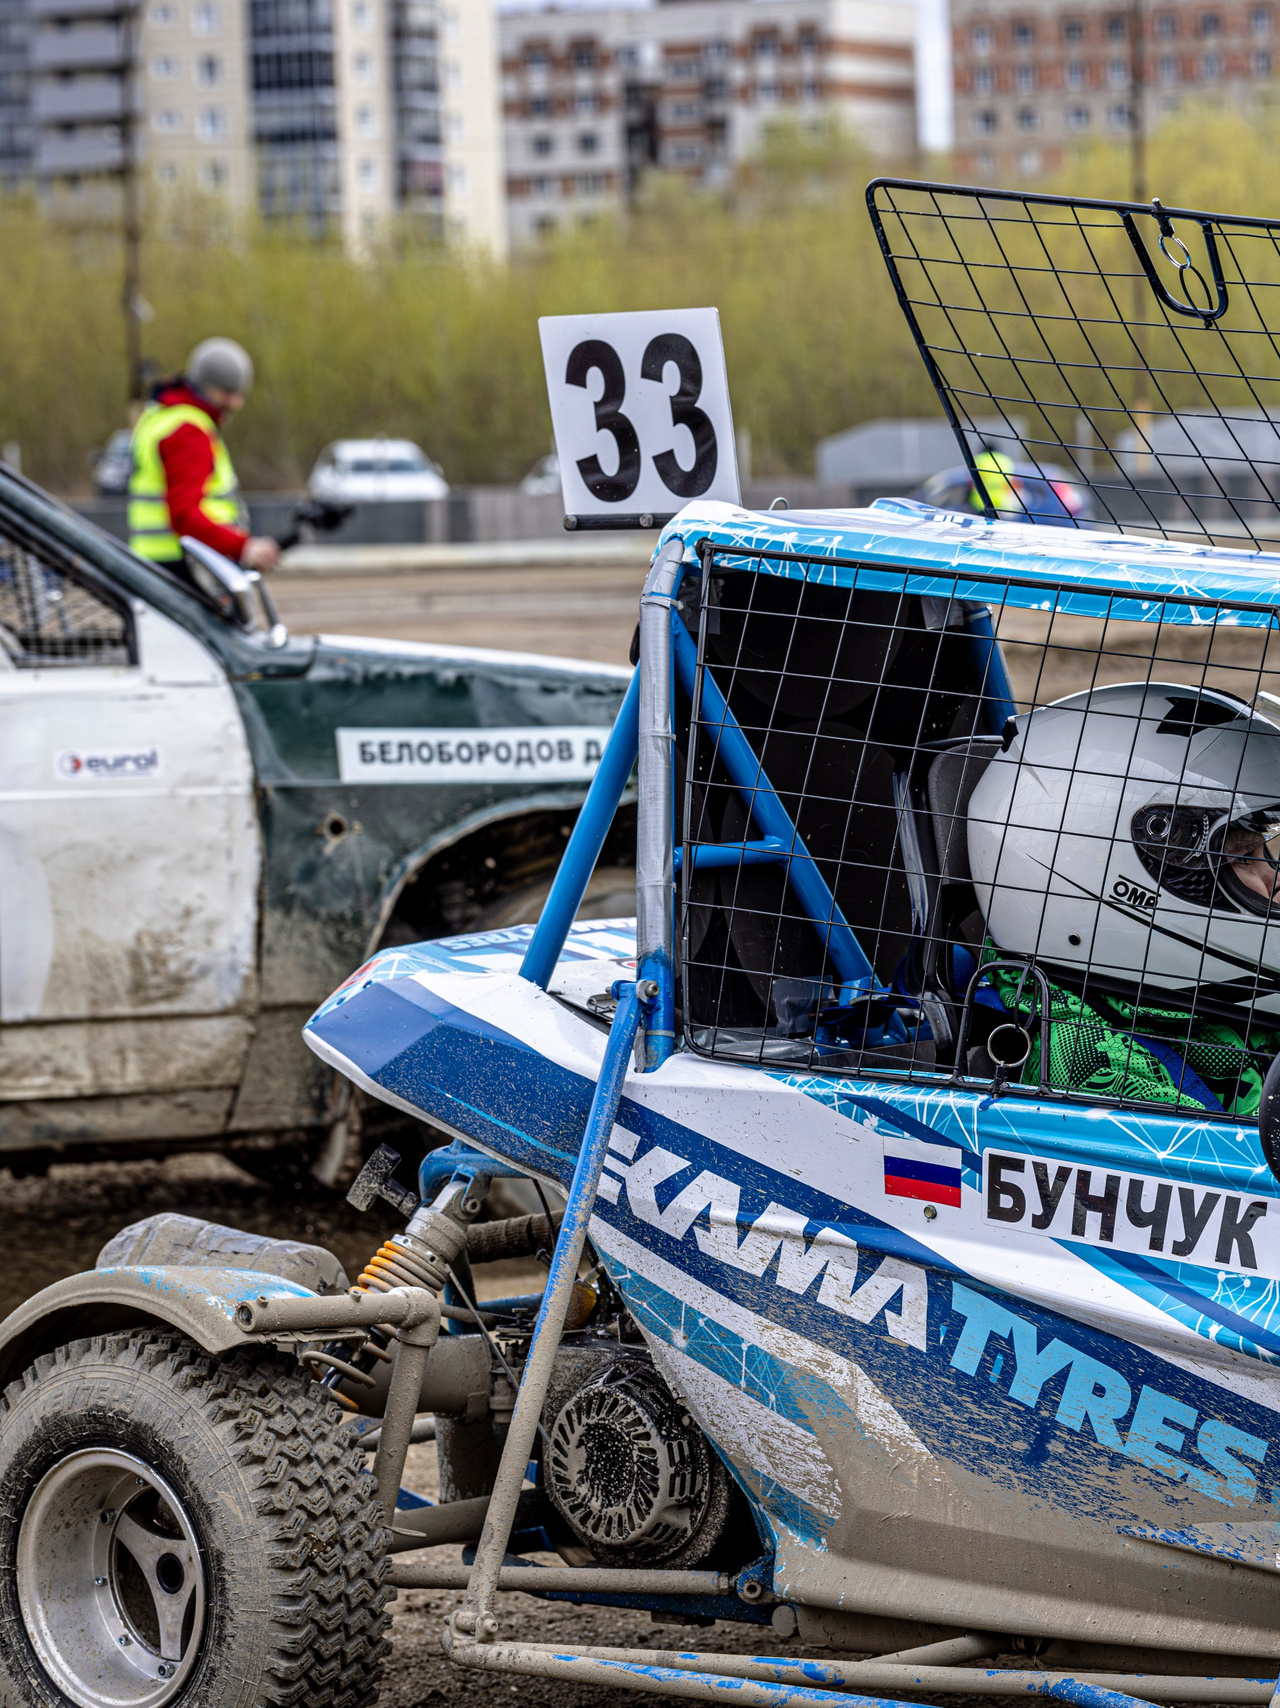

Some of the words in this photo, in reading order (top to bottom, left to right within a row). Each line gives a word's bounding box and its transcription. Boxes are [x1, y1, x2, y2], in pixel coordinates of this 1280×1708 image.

[564, 333, 718, 503] 33
[359, 739, 574, 768] БЕЛОБОРОДОВ
[986, 1152, 1269, 1271] БУНЧУК
[596, 1121, 930, 1353] KAMA
[949, 1280, 1269, 1507] TYRES
